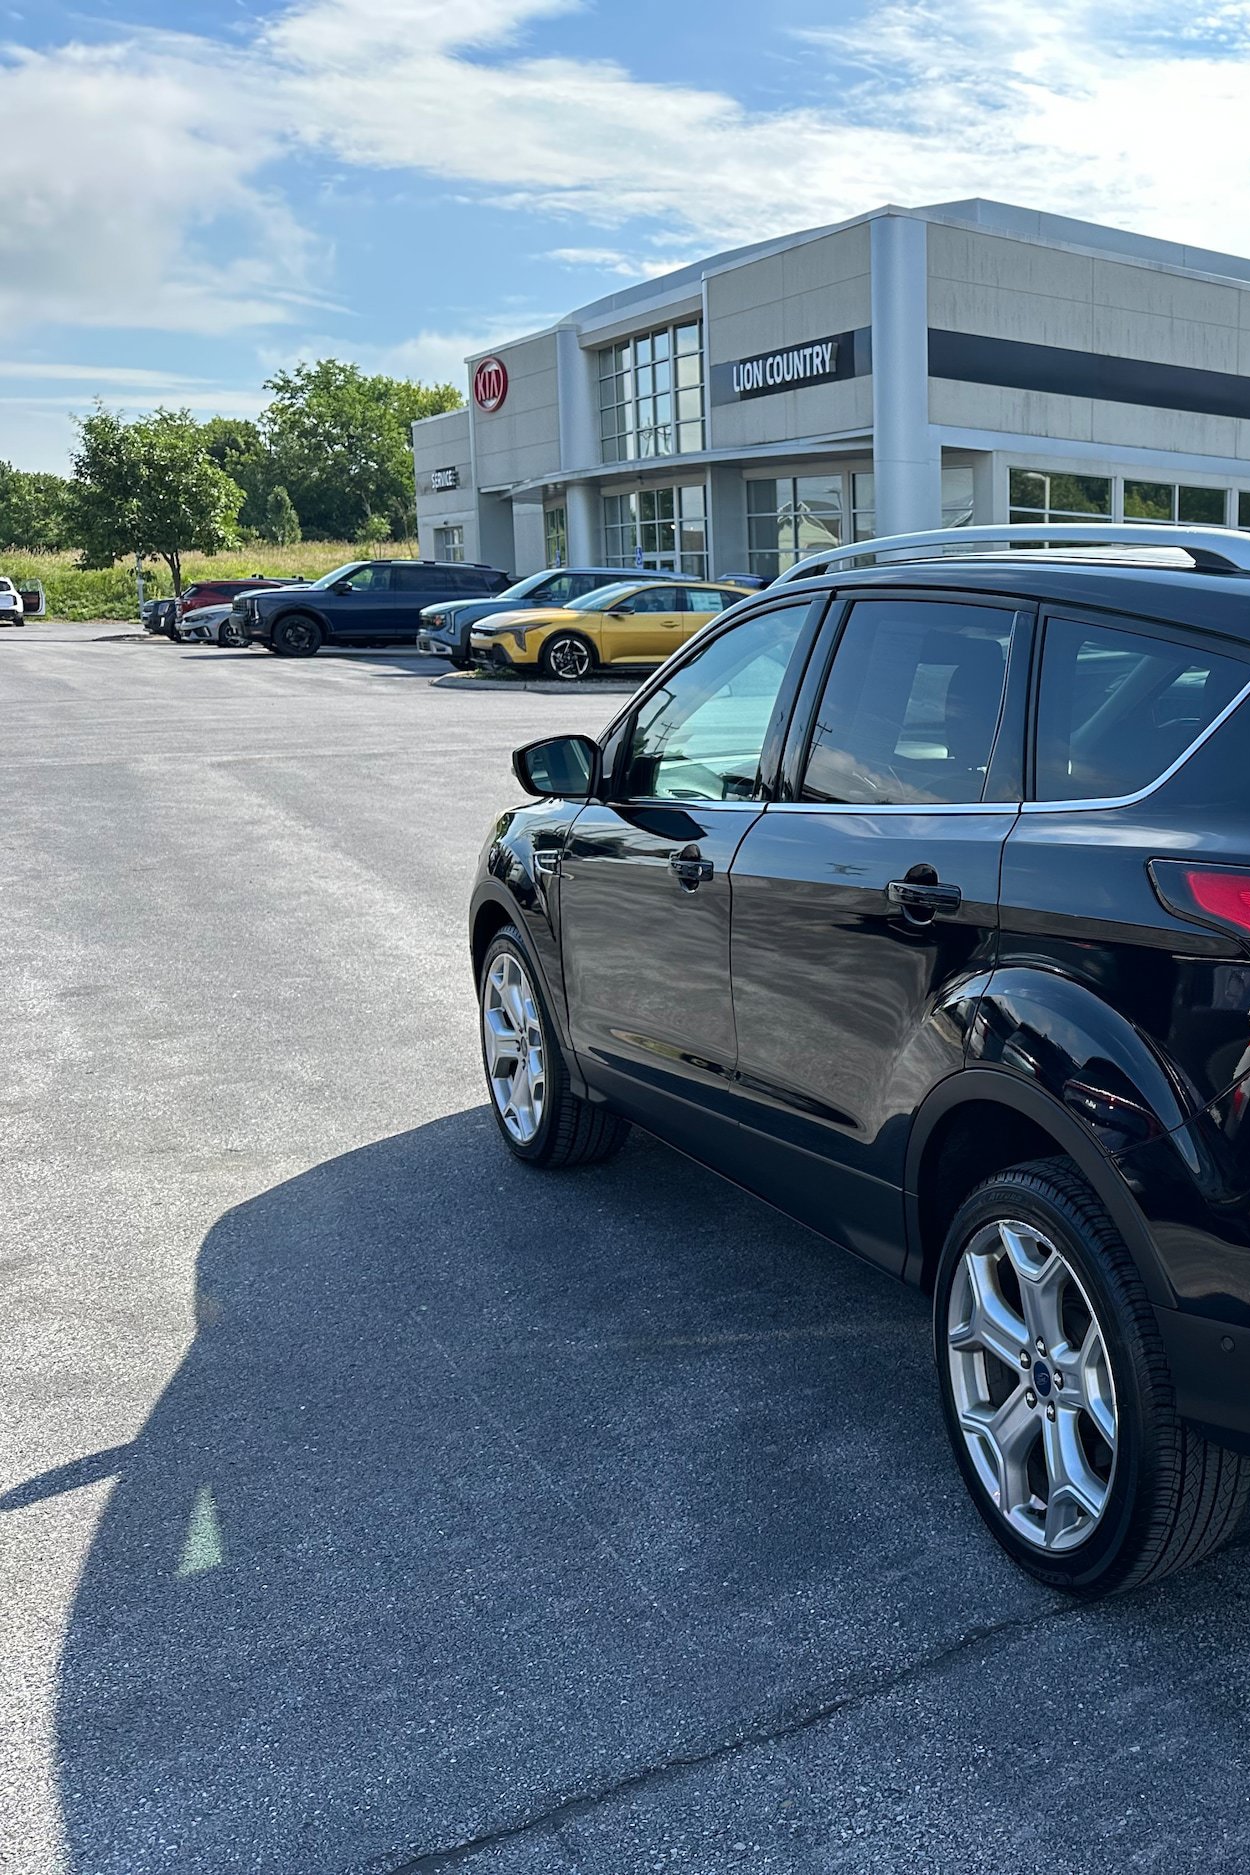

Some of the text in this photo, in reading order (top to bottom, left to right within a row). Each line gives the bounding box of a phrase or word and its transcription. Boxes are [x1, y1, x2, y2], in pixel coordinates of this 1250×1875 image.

[477, 370, 499, 401] KIA
[733, 342, 832, 393] LION COUNTRY
